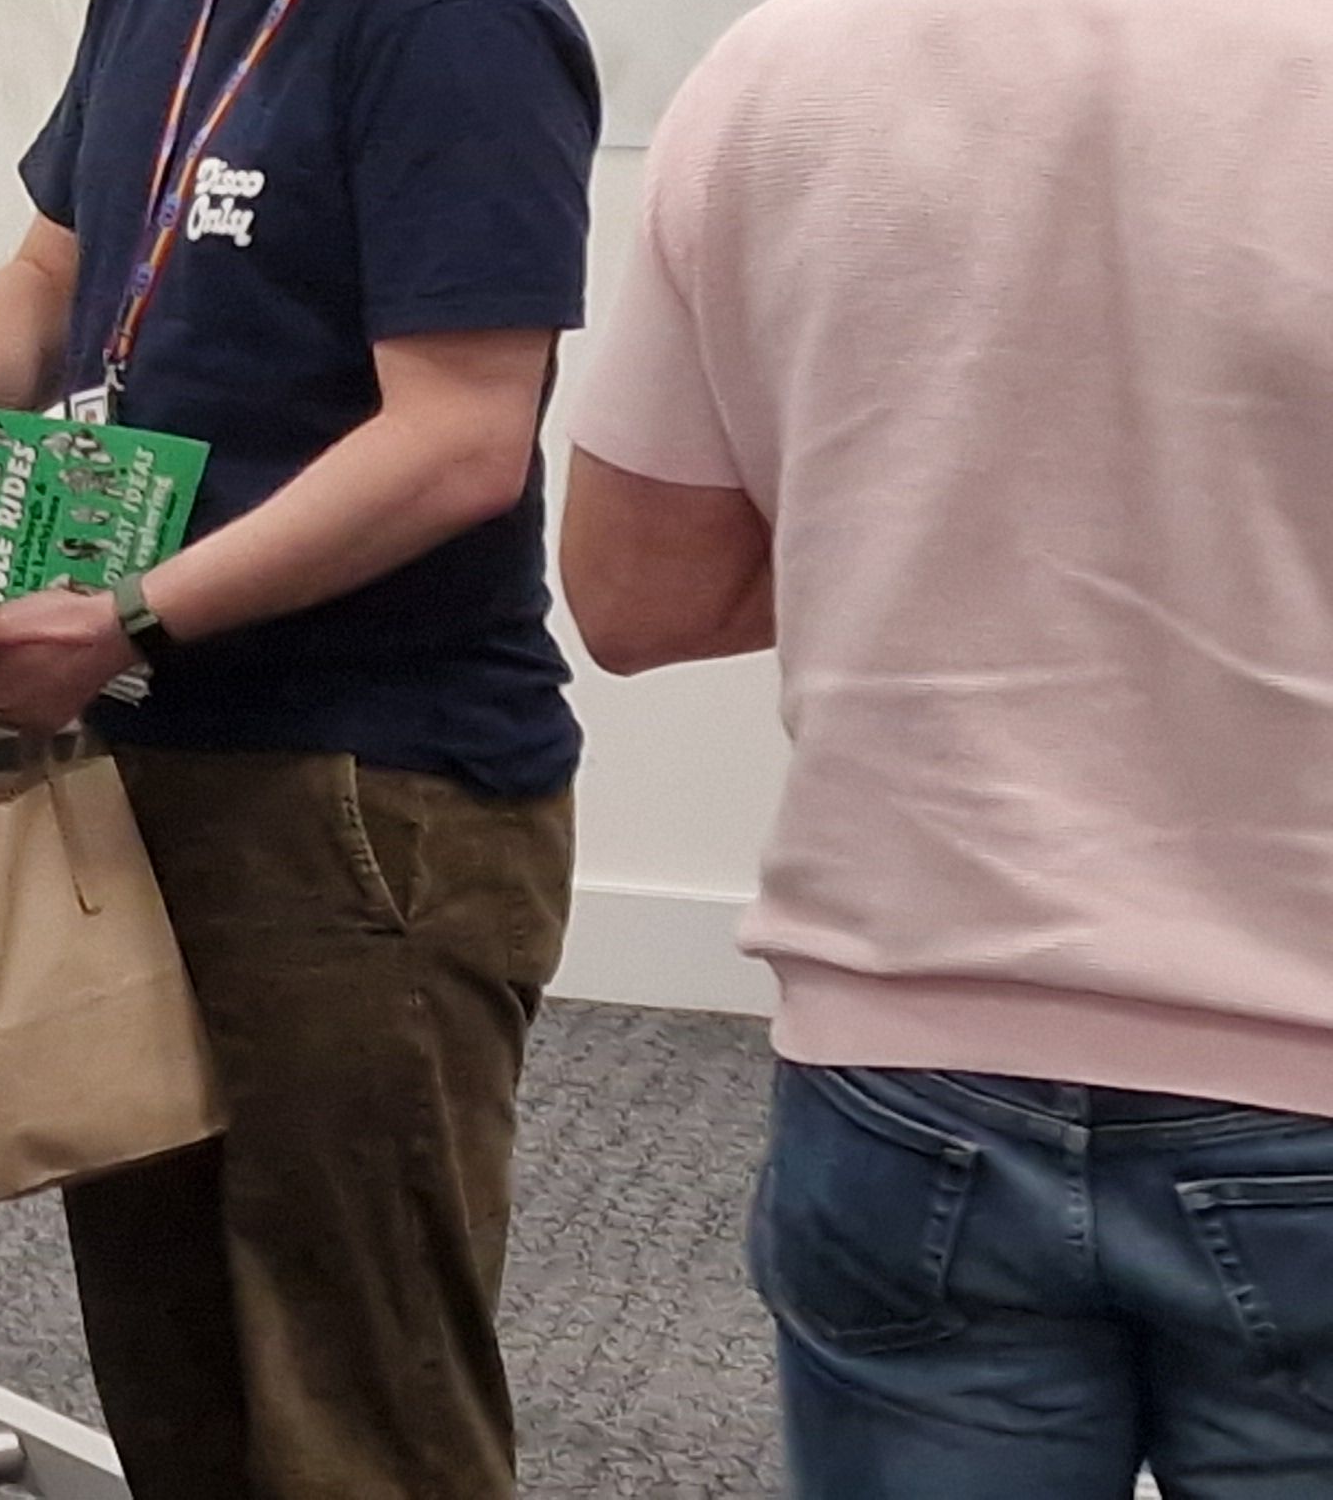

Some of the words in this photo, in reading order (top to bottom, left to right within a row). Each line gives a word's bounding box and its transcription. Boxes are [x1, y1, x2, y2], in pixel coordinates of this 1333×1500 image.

[194, 157, 265, 198] Disco
[187, 194, 254, 248] Only
[122, 445, 156, 513] IDEAS
